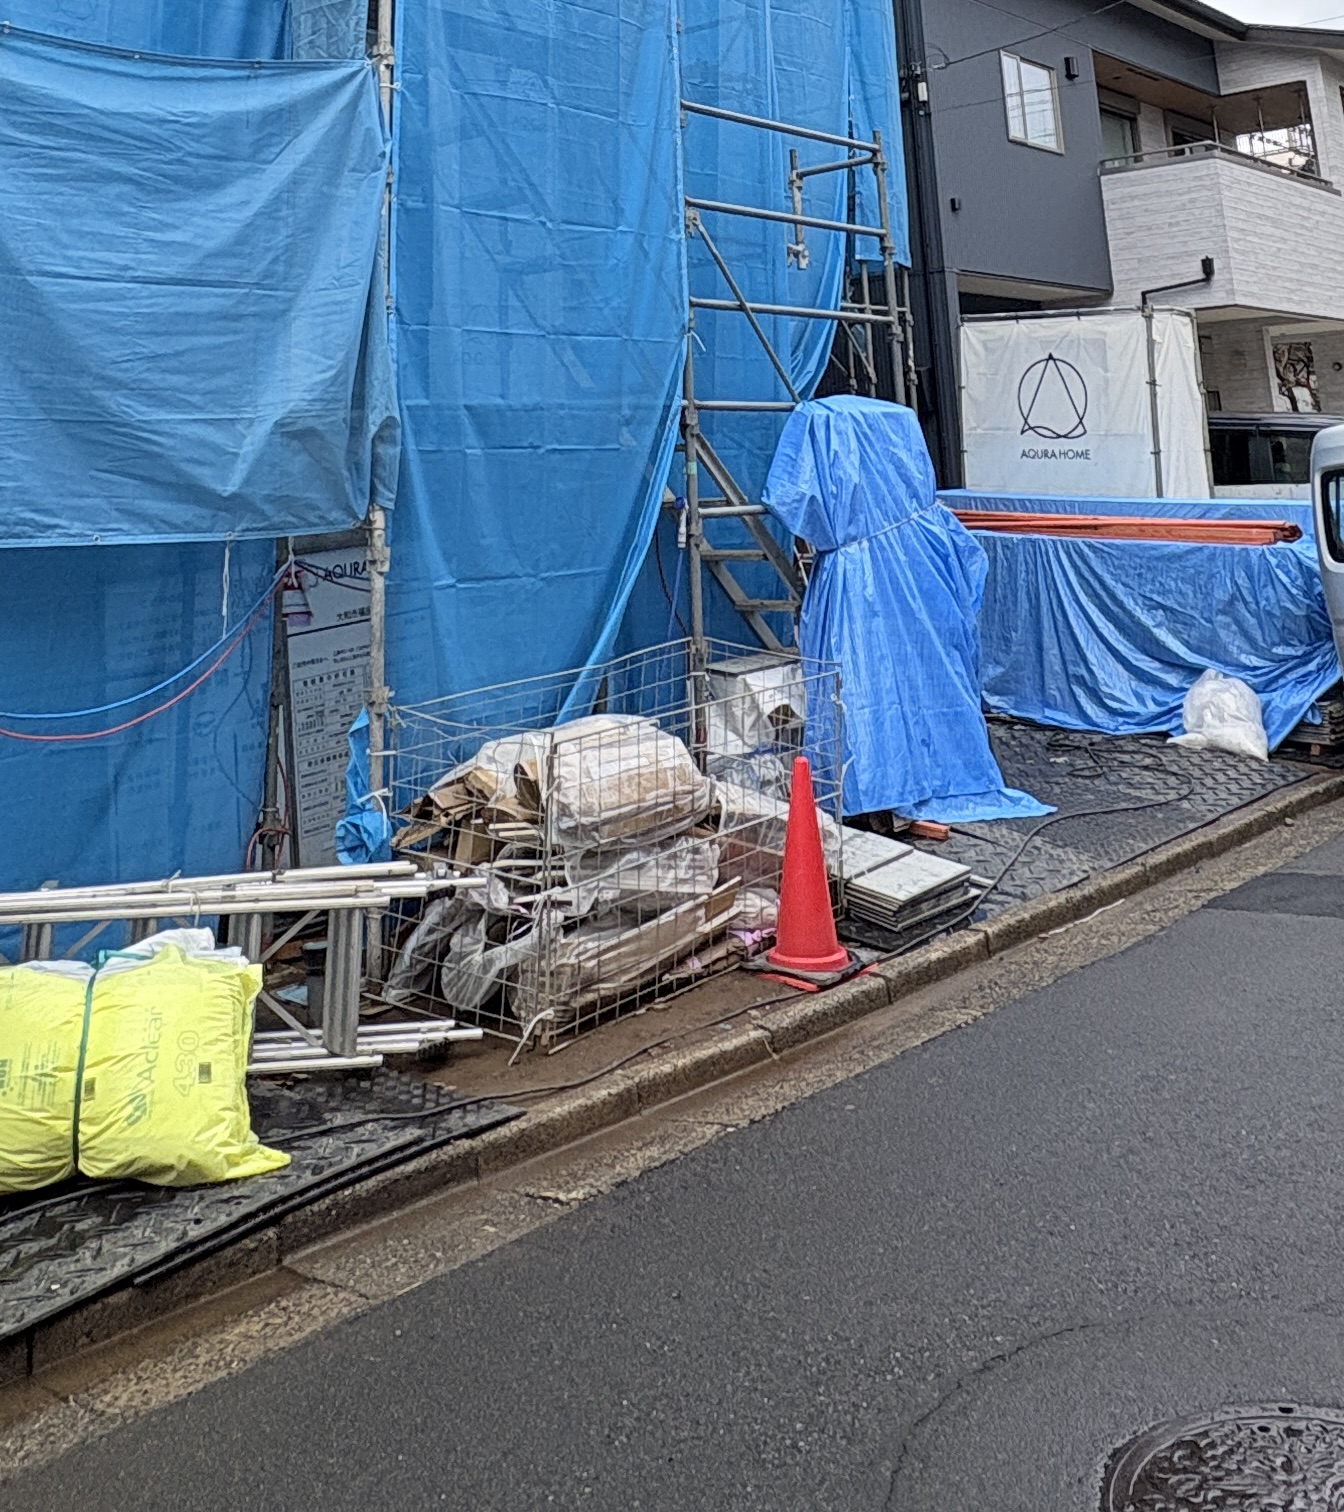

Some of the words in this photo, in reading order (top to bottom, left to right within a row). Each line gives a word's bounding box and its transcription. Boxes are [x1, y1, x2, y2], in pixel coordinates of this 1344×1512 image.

[1020, 448, 1057, 461] AQURA
[1058, 448, 1092, 461] HOME
[172, 1029, 200, 1098] 430
